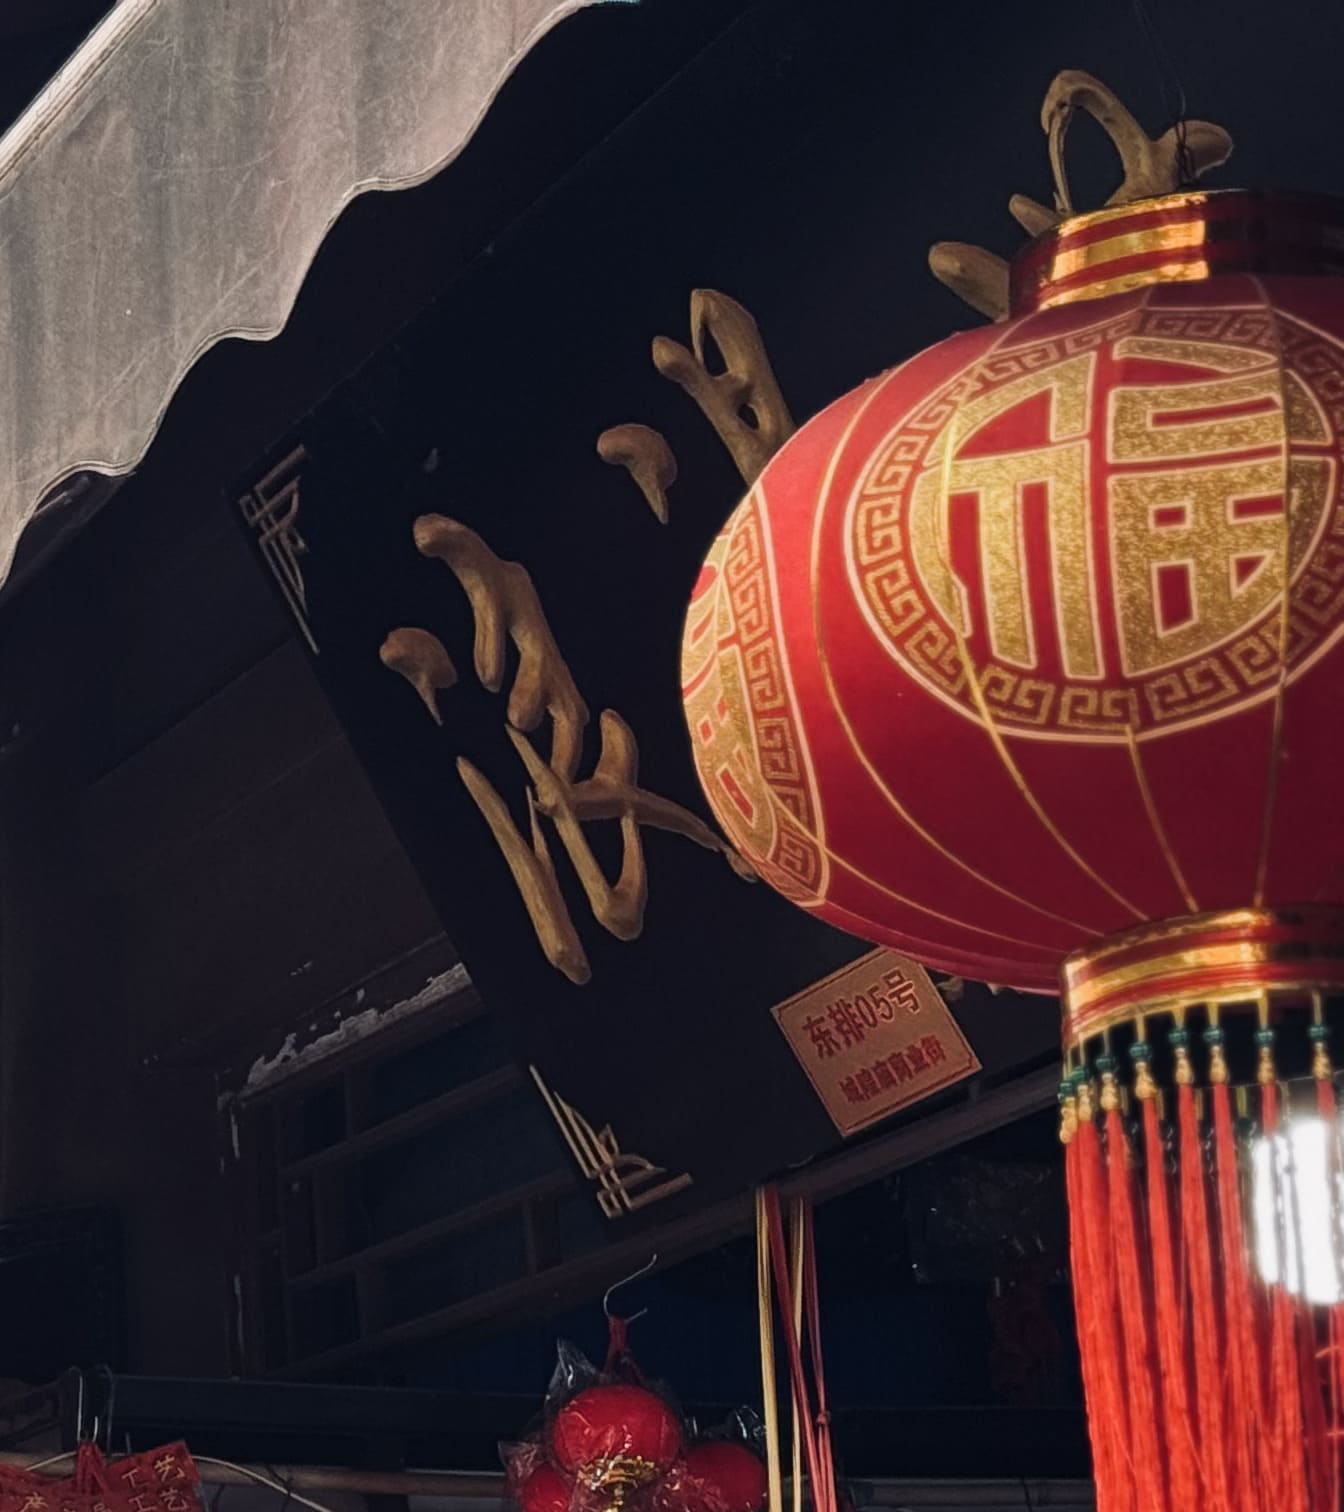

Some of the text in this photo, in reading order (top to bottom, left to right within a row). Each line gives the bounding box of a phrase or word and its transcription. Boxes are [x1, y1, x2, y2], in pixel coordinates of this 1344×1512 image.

[909, 336, 1335, 685] 福
[803, 967, 920, 1060] 东排05号
